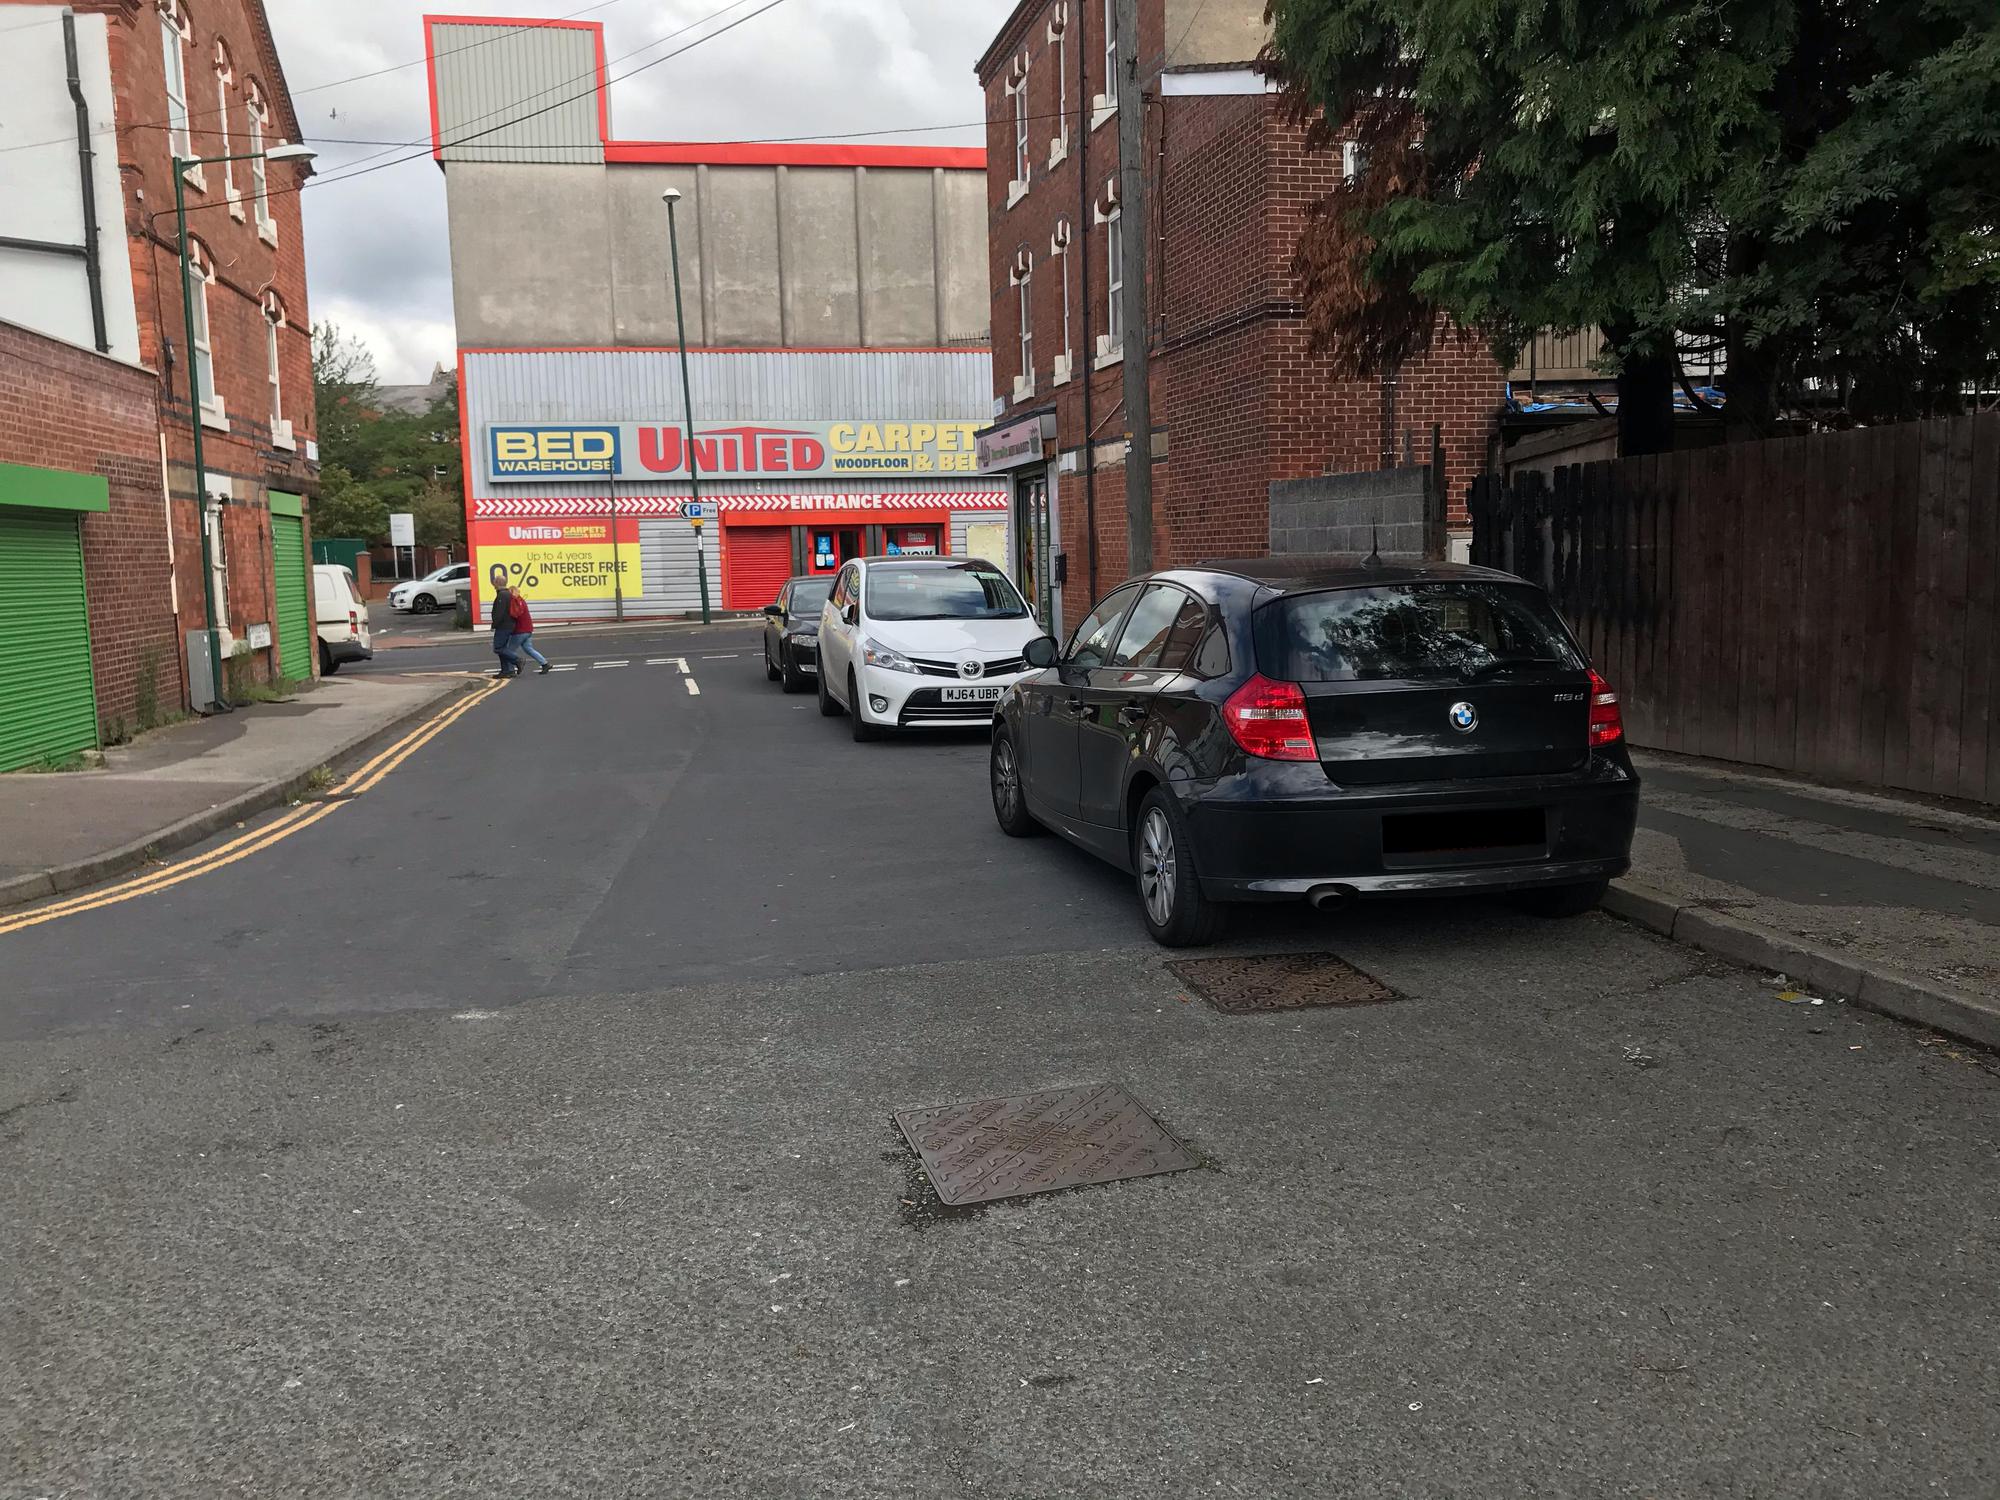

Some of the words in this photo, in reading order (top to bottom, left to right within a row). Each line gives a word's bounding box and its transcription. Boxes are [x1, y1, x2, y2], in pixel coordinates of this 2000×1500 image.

[496, 431, 614, 460] BED
[638, 426, 825, 472] UNITED
[829, 423, 994, 453] CARPET
[498, 460, 615, 472] WAREHOUSE
[834, 458, 909, 469] WOODFLOOR
[914, 453, 934, 472] &
[790, 494, 882, 510] ENTRANCE
[509, 526, 562, 539] UNITED
[563, 526, 606, 534] CARPETS
[527, 552, 537, 561] Up
[543, 552, 553, 560] to
[557, 552, 563, 560] 4
[566, 552, 592, 561] years
[540, 562, 595, 574] INTEREST
[598, 561, 628, 573] FREE
[562, 575, 608, 587] CREDIT
[946, 689, 975, 700] MJ64
[978, 688, 999, 699] UBR
